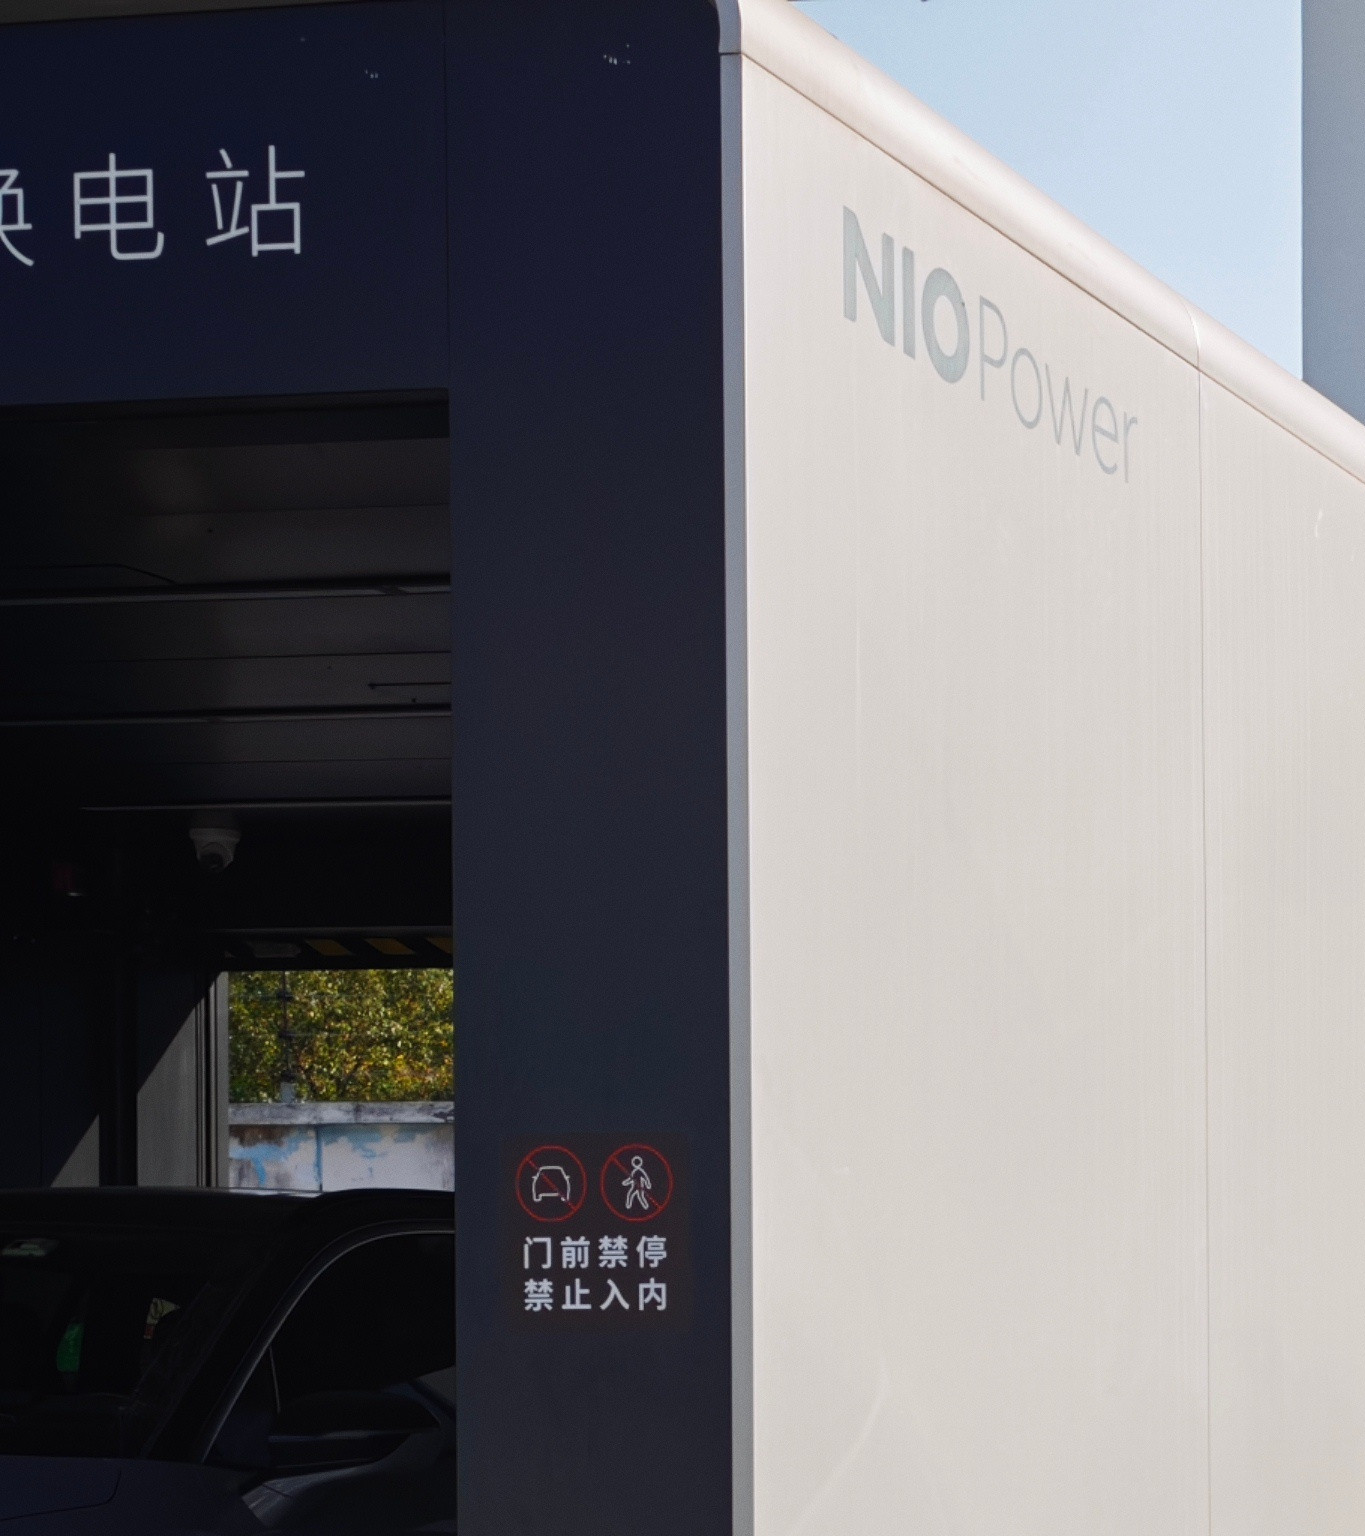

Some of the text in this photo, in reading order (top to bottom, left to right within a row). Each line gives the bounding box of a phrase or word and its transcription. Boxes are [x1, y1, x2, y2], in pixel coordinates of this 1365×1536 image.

[523, 1235, 667, 1269] 门前禁停
[524, 1278, 667, 1312] 禁止入内
